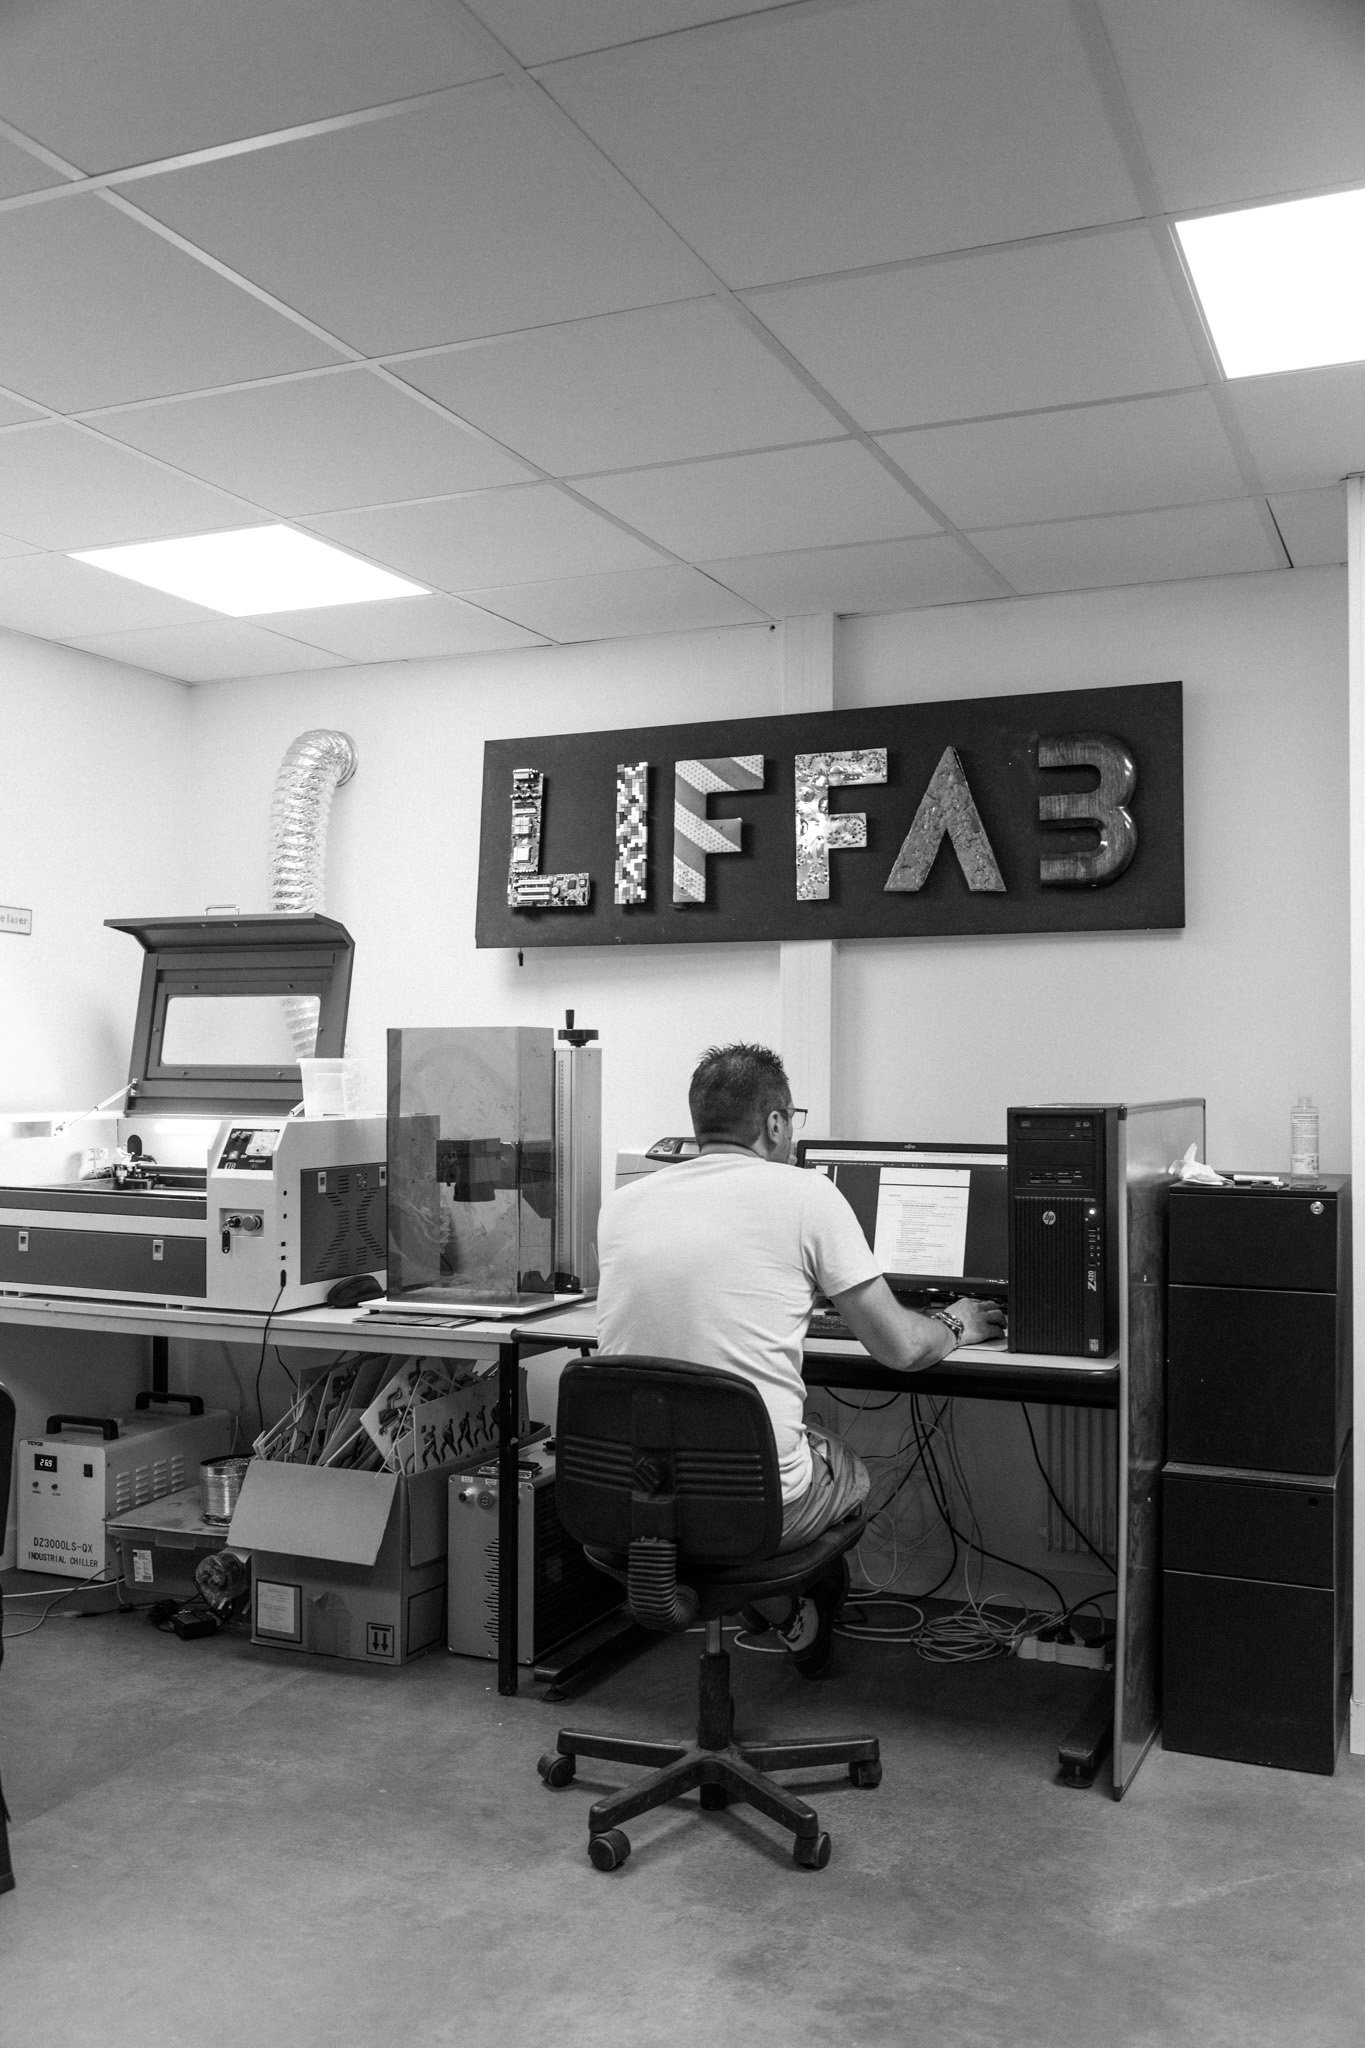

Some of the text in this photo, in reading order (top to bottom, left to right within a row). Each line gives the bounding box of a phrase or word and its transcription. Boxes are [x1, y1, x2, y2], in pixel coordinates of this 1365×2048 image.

[33, 1536, 93, 1553] DZ3000LS-QX
[28, 1551, 98, 1568] INDUSTRIAL CHILLER
